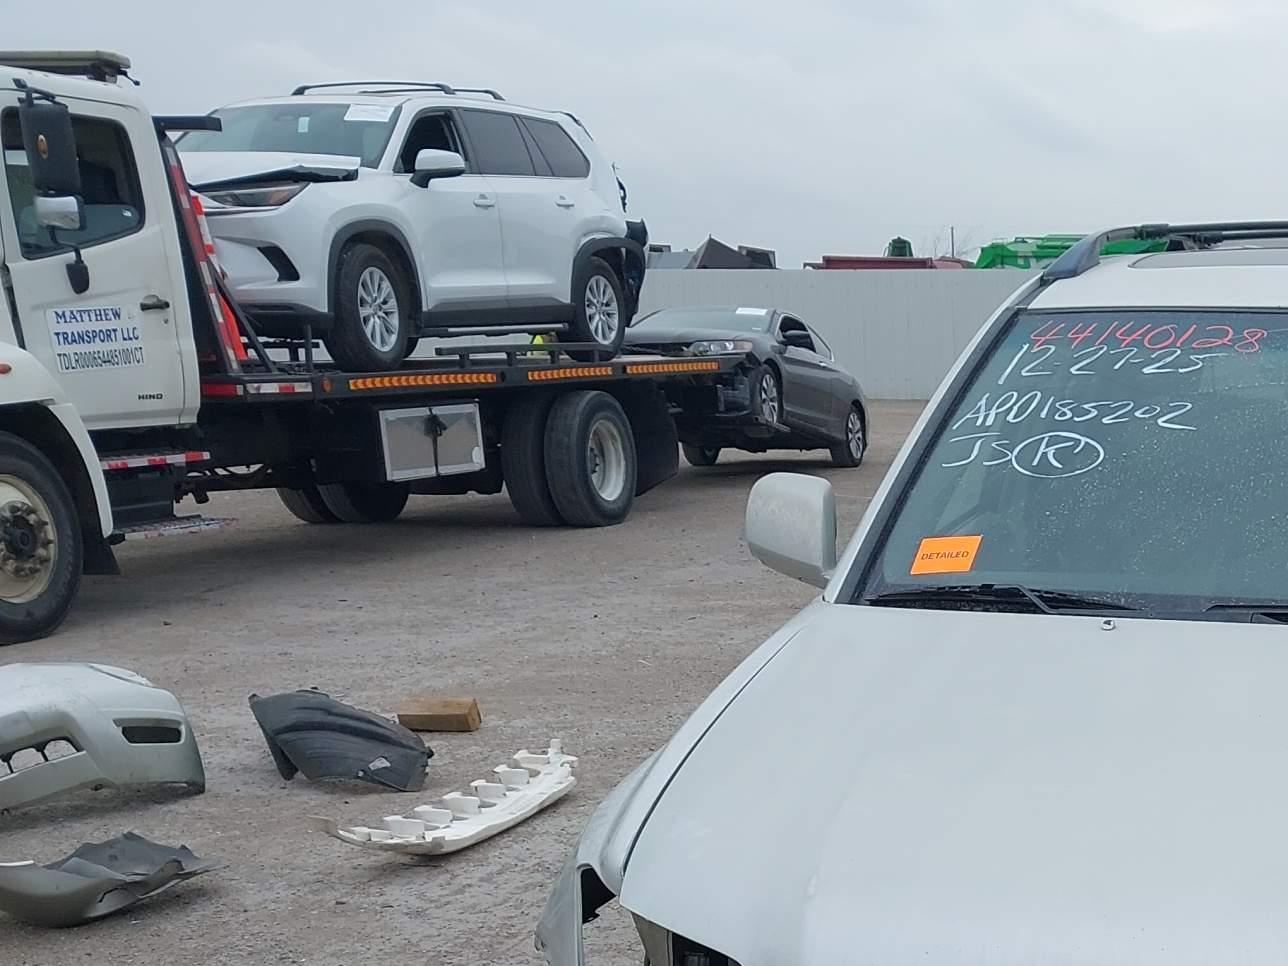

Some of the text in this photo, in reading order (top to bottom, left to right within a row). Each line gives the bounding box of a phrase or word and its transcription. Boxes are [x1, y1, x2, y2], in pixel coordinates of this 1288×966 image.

[53, 307, 121, 324] MATTHEW
[54, 328, 140, 346] TRANSPORT LLC
[1030, 320, 1268, 352] 44140128
[921, 550, 969, 560] DETAILED
